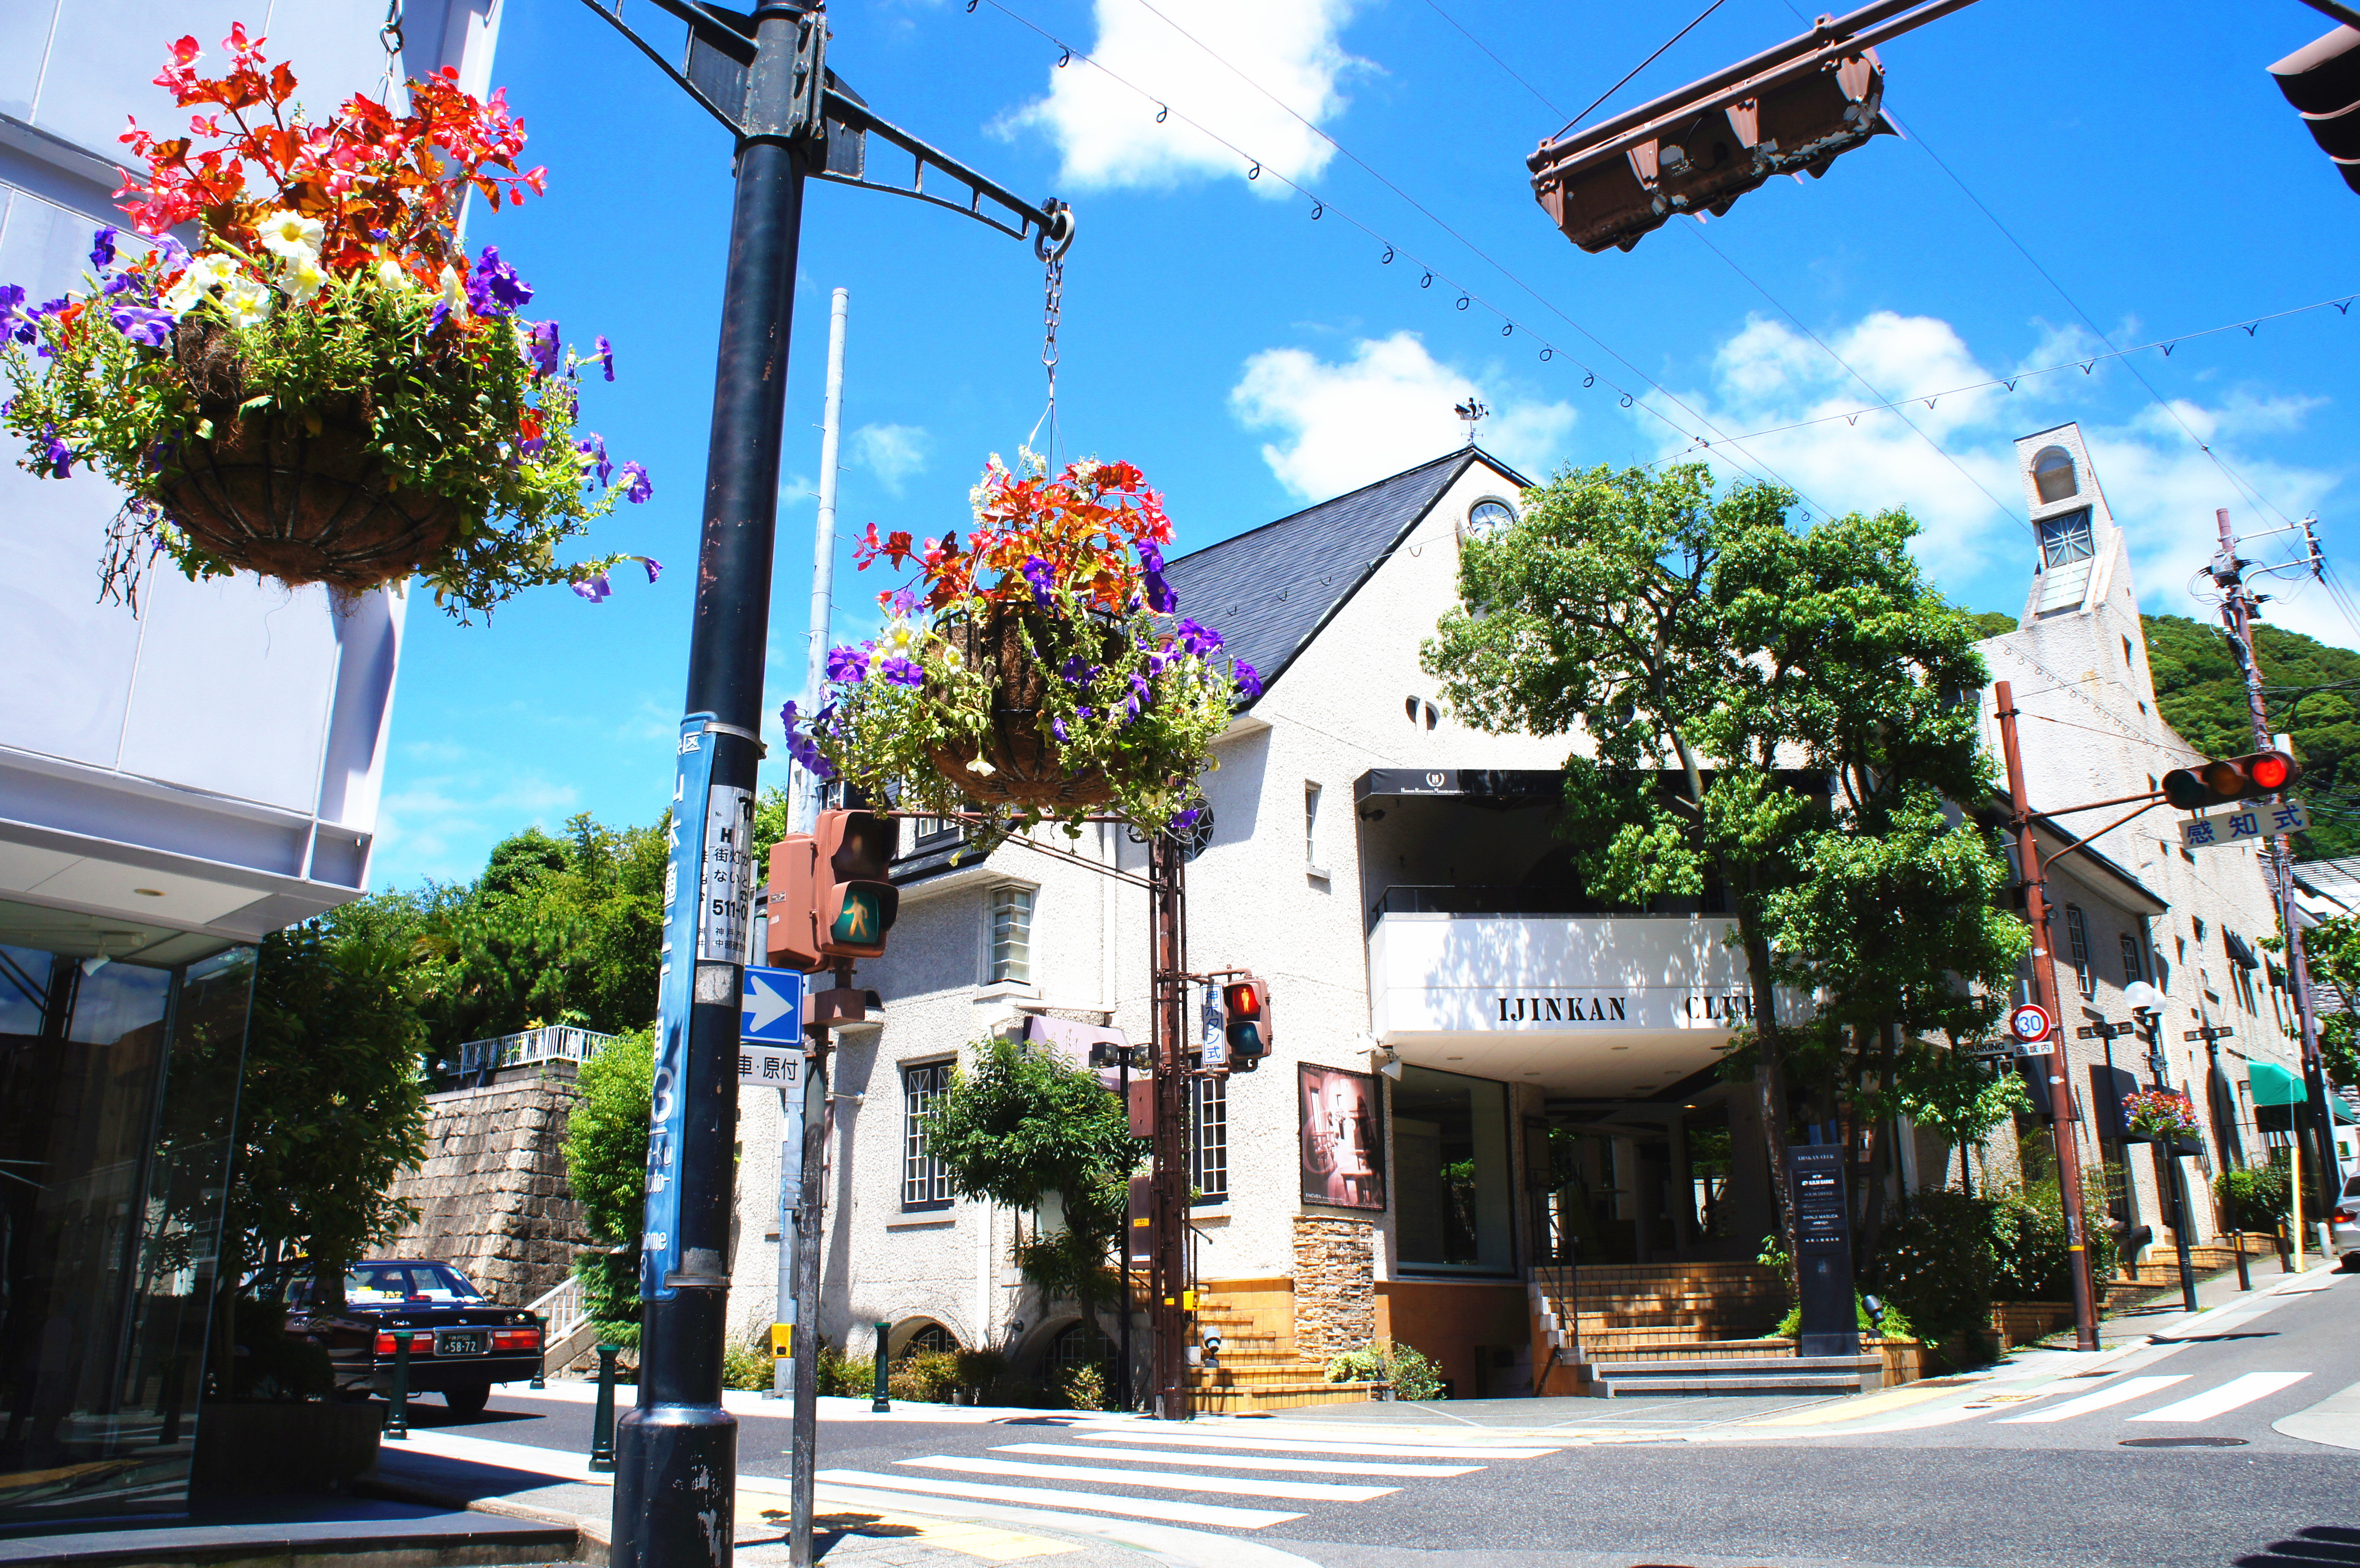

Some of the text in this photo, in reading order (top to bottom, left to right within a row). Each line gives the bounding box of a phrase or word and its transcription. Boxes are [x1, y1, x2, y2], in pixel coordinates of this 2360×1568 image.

[2186, 804, 2303, 840] 感知式
[1498, 997, 1626, 1021] IJINKAN
[2019, 1015, 2042, 1032] 30
[1205, 990, 1221, 1059] 押ボタン式
[652, 1066, 674, 1123] 3
[450, 1341, 476, 1352] 58-72
